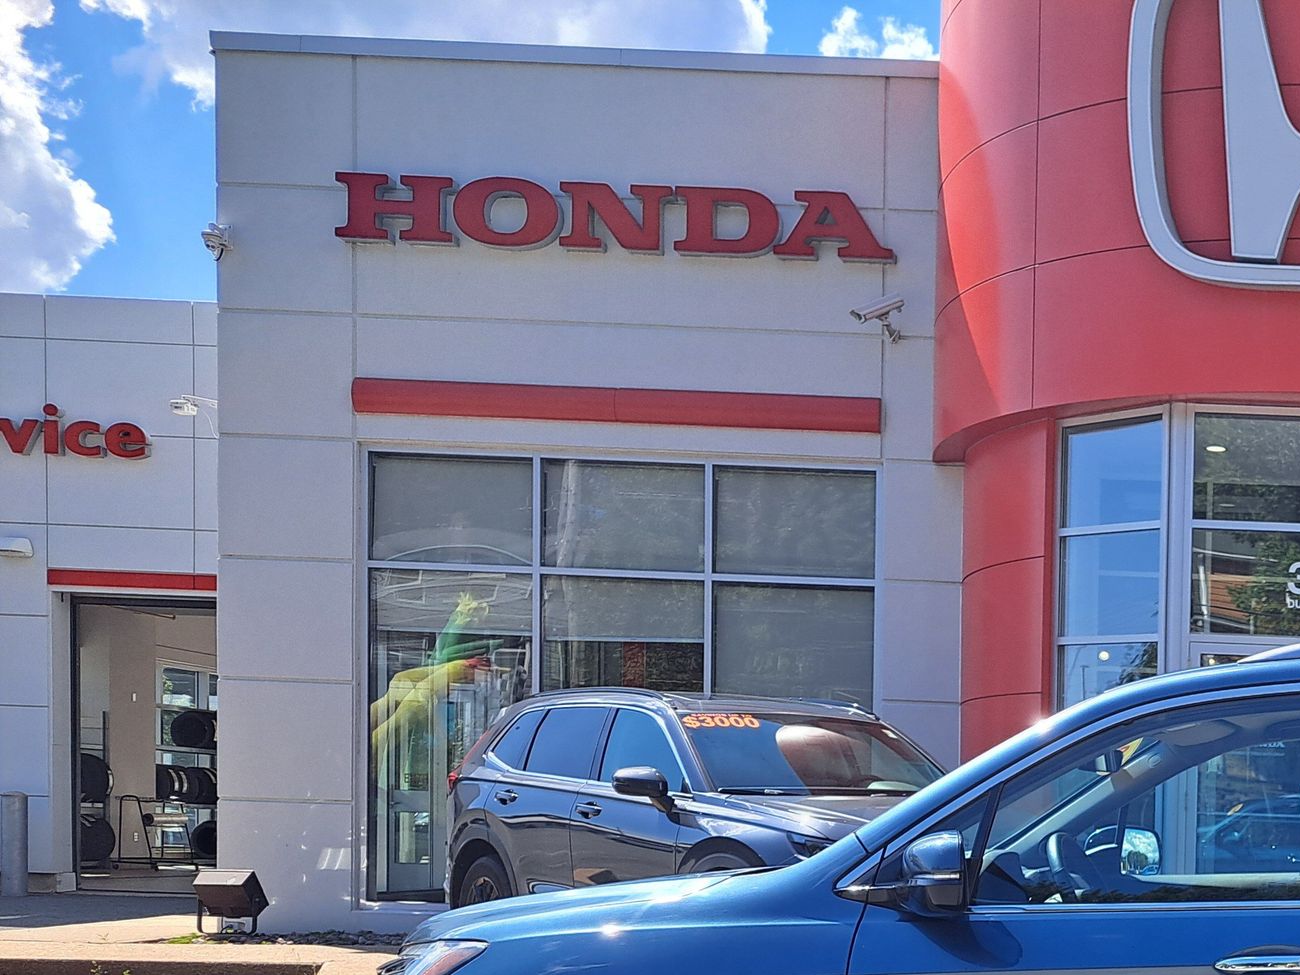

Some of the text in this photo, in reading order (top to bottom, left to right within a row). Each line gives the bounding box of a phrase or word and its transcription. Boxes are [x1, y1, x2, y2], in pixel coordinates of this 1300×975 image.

[335, 171, 896, 261] HONDA
[0, 402, 149, 459] vice
[682, 715, 760, 728] $3000
